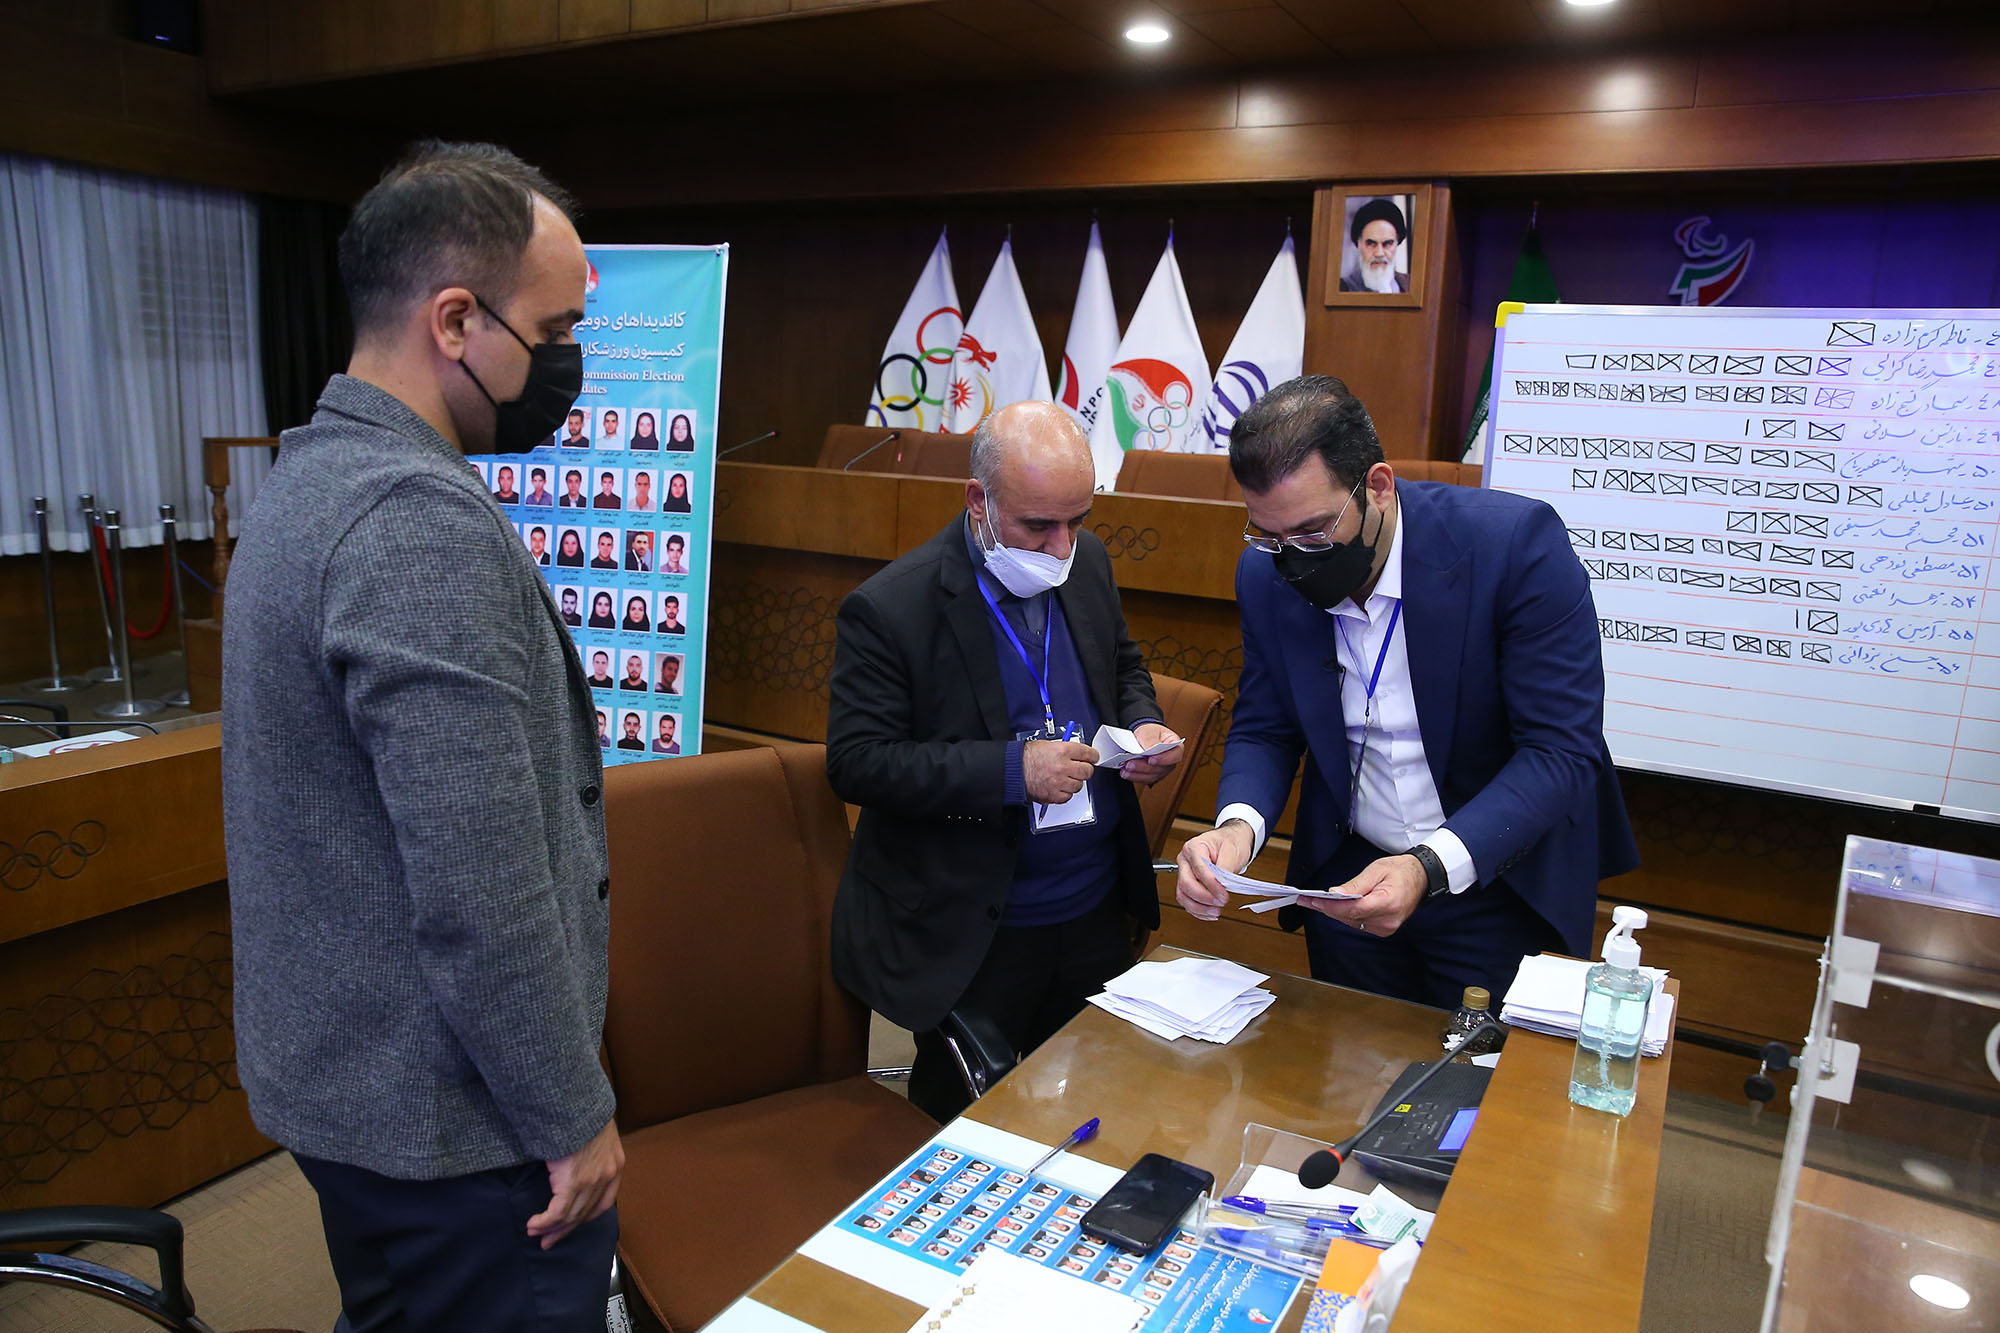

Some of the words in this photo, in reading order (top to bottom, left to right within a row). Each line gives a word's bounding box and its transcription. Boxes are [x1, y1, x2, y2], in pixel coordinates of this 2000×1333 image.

[571, 314, 609, 331] دومی
[611, 312, 687, 333] کاندیداهای
[580, 341, 630, 360] ورزشکارا
[631, 342, 685, 361] کمیسیون
[583, 370, 639, 381] ommission
[642, 370, 685, 382] Election
[1888, 592, 1945, 607] زهرا
